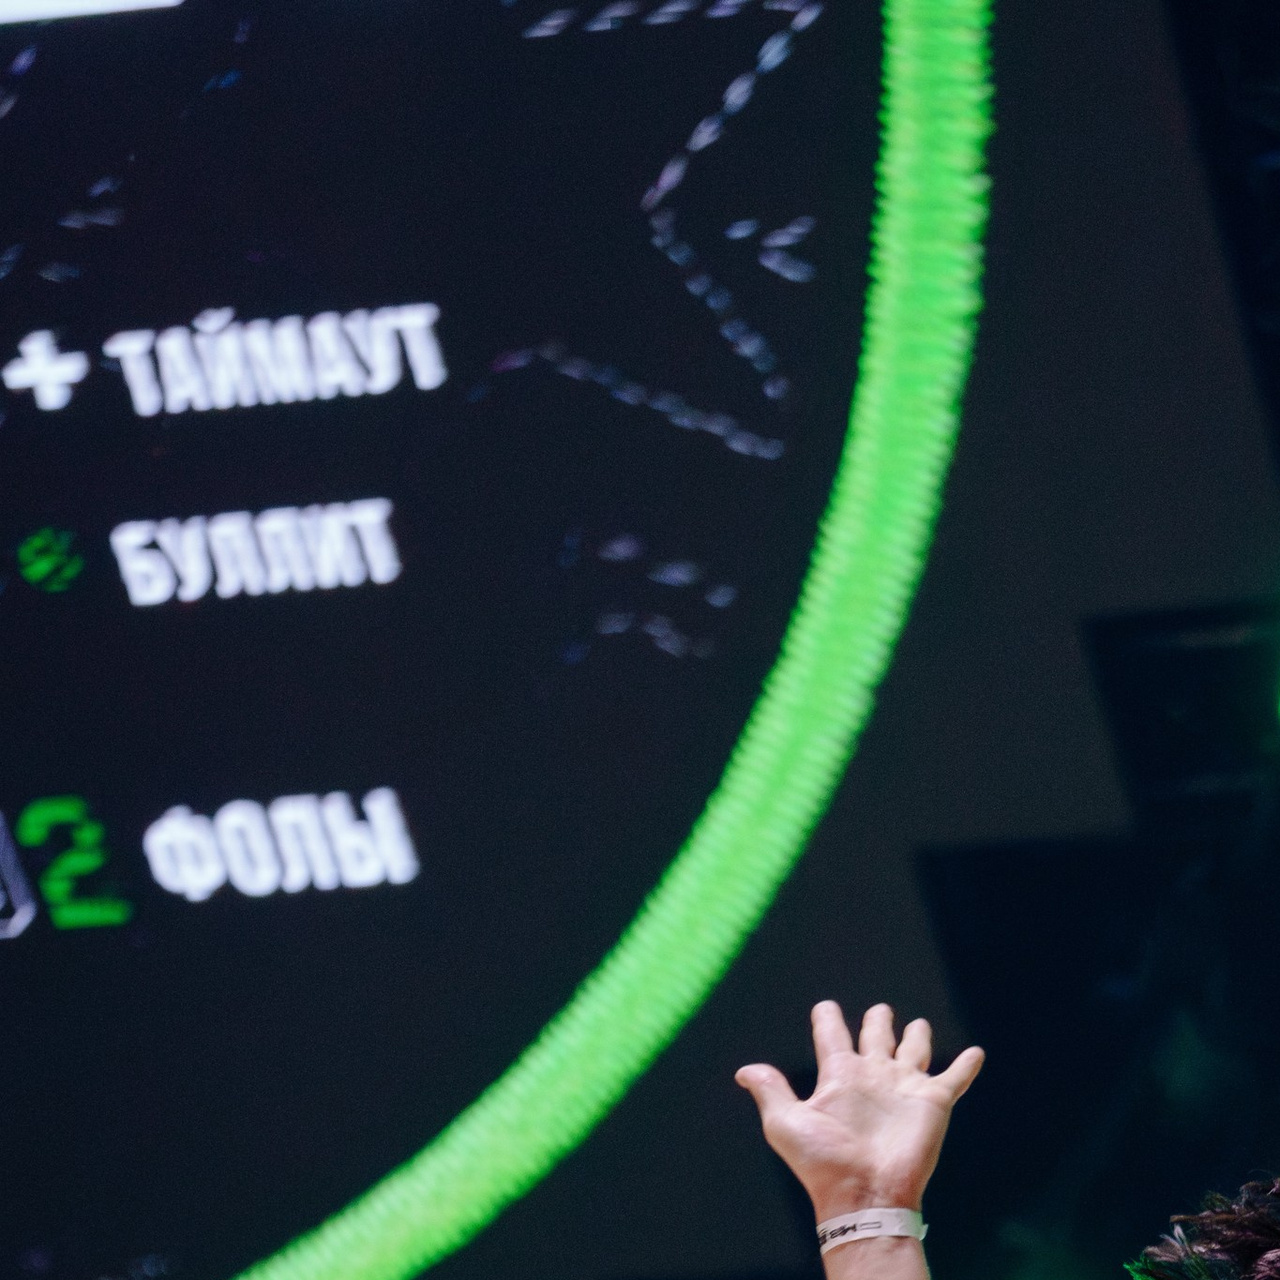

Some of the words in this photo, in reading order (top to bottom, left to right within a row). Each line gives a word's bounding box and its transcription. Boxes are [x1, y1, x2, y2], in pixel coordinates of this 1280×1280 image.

[103, 303, 448, 417] ТАЙМАУТ
[109, 497, 402, 606] БУЛЛИТ
[16, 796, 131, 928] 2
[142, 787, 419, 902] ФОЛЫ
